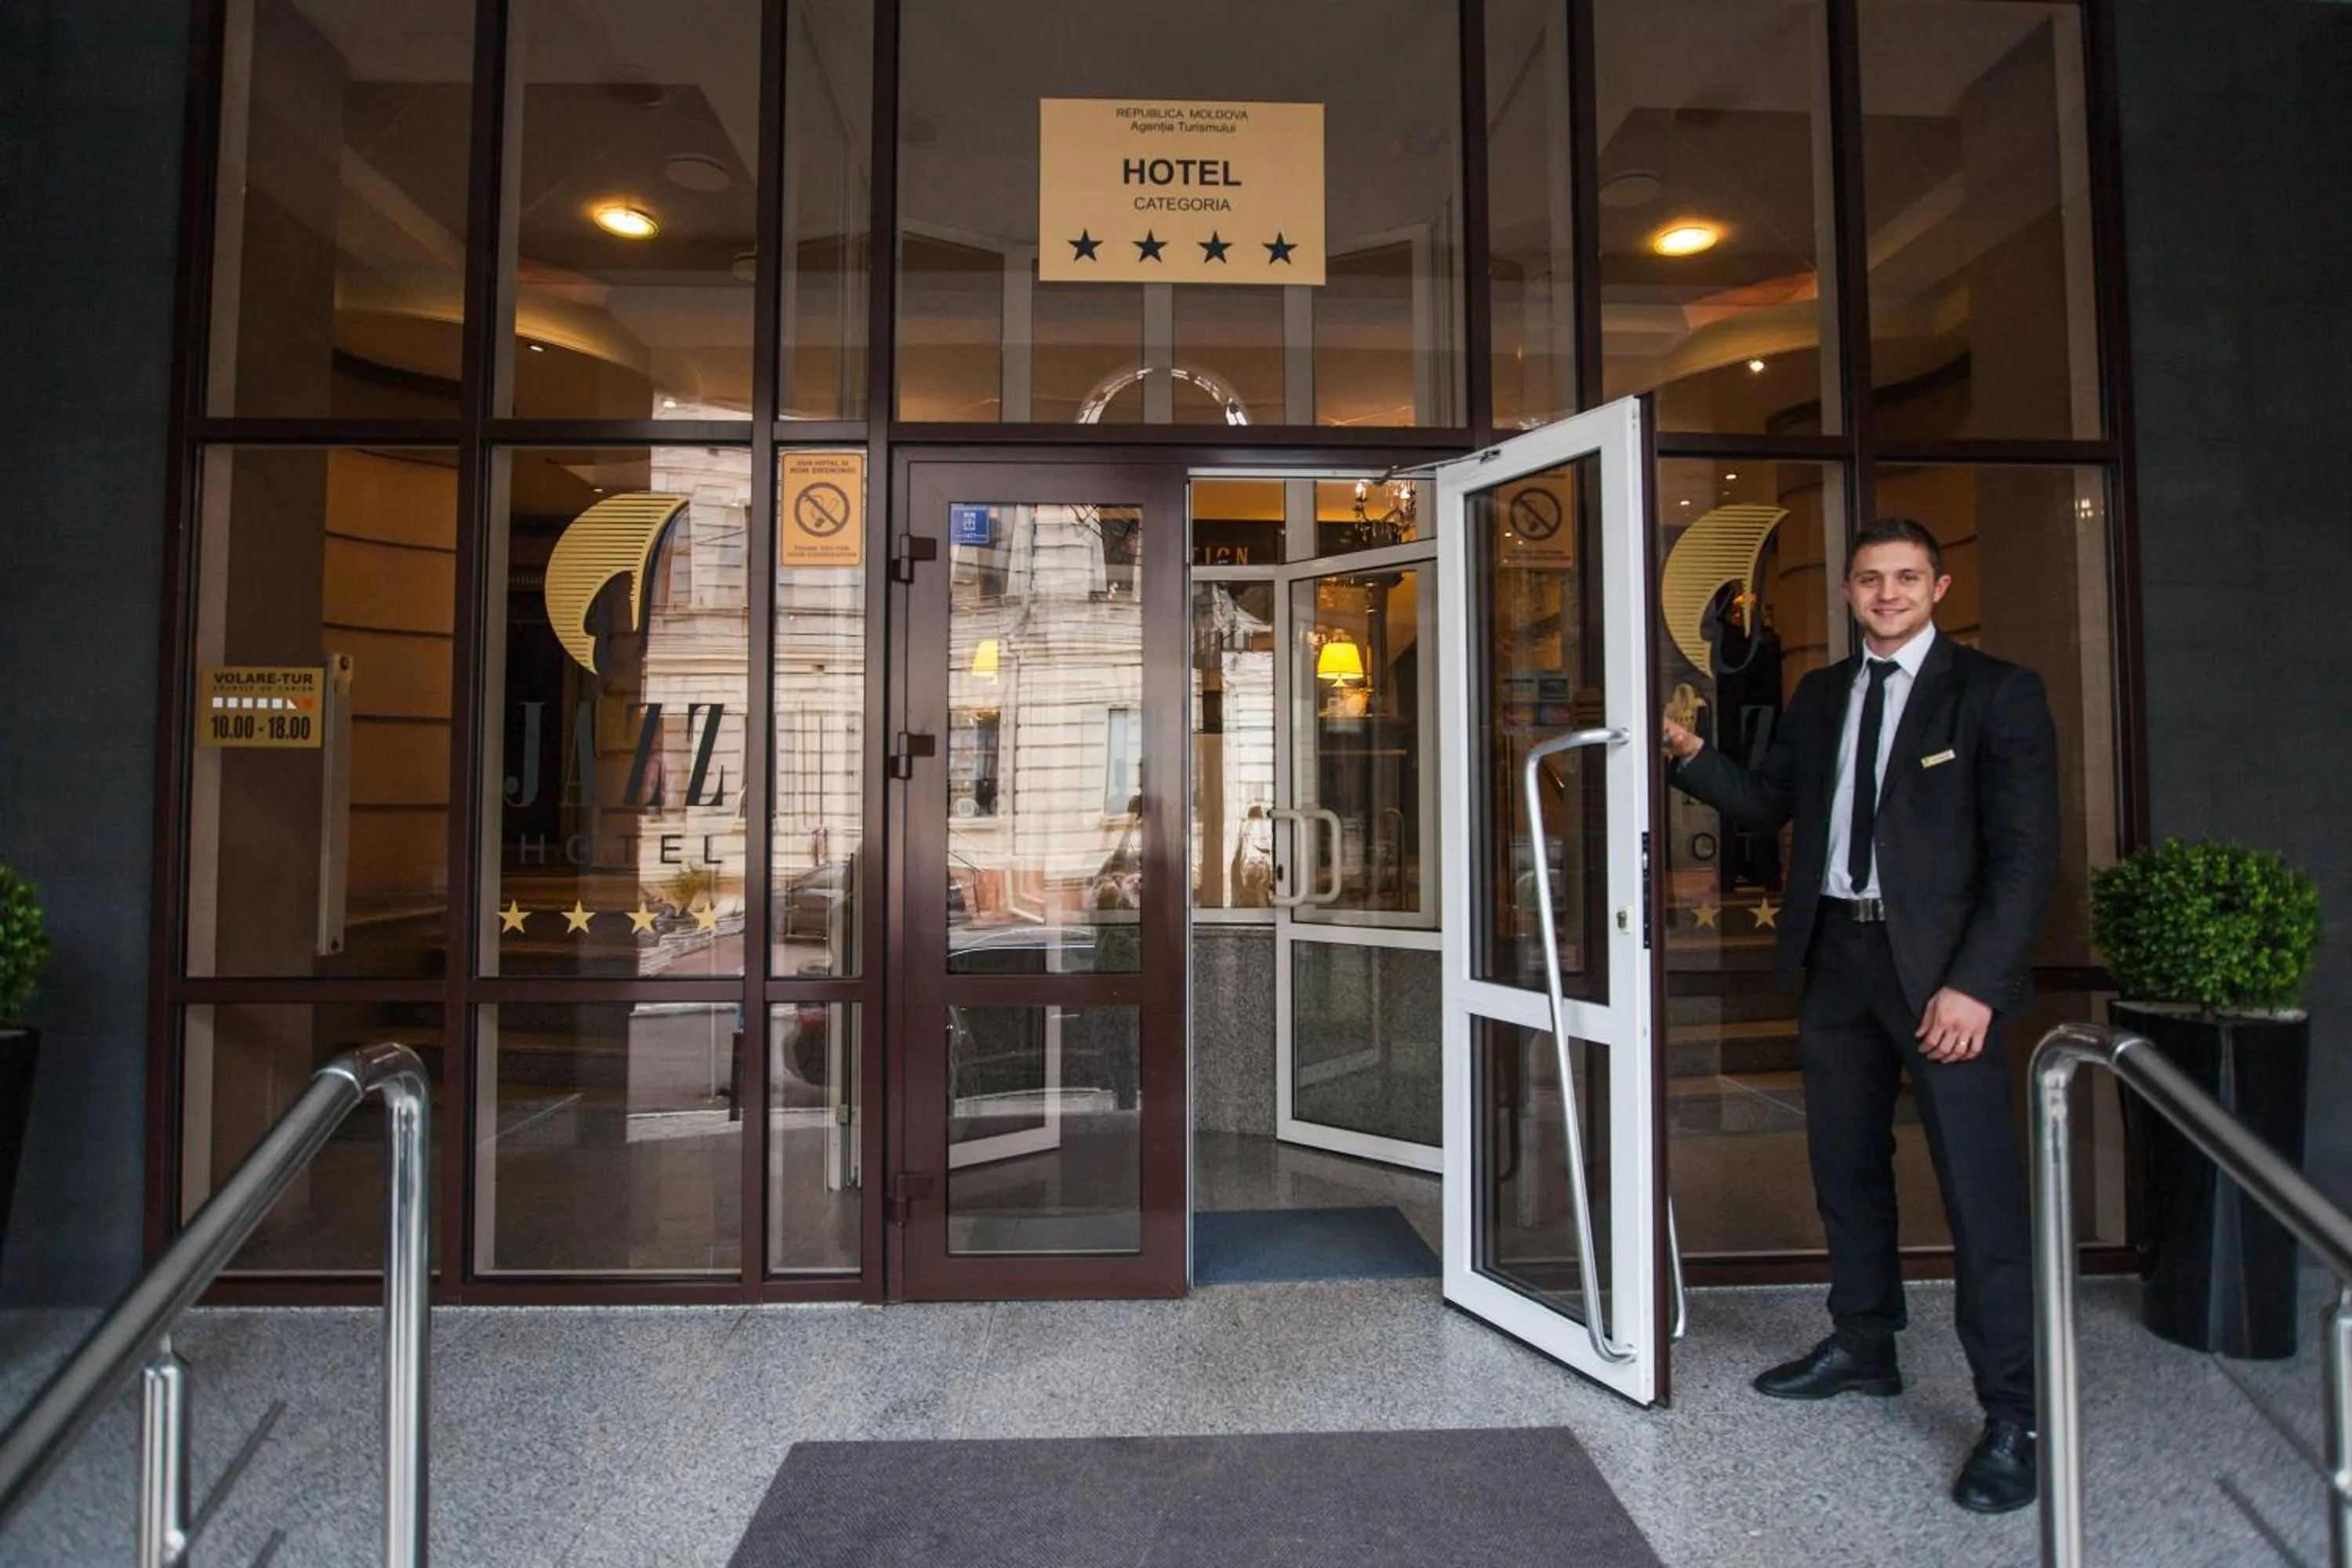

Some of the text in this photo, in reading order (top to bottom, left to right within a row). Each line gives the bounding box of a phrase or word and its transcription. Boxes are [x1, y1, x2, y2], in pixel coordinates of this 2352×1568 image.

[1116, 107, 1249, 120] REPUBLICA MOLDOVA
[1178, 122, 1236, 132] Turismului
[1123, 158, 1242, 186] HOTEL
[1134, 197, 1232, 212] CATEGORIA
[213, 673, 313, 684] VOLARE-TUR
[212, 715, 255, 739] 10.00
[268, 716, 310, 740] 18.00
[503, 702, 724, 808] JAZZ
[519, 833, 723, 865] HOTEL
